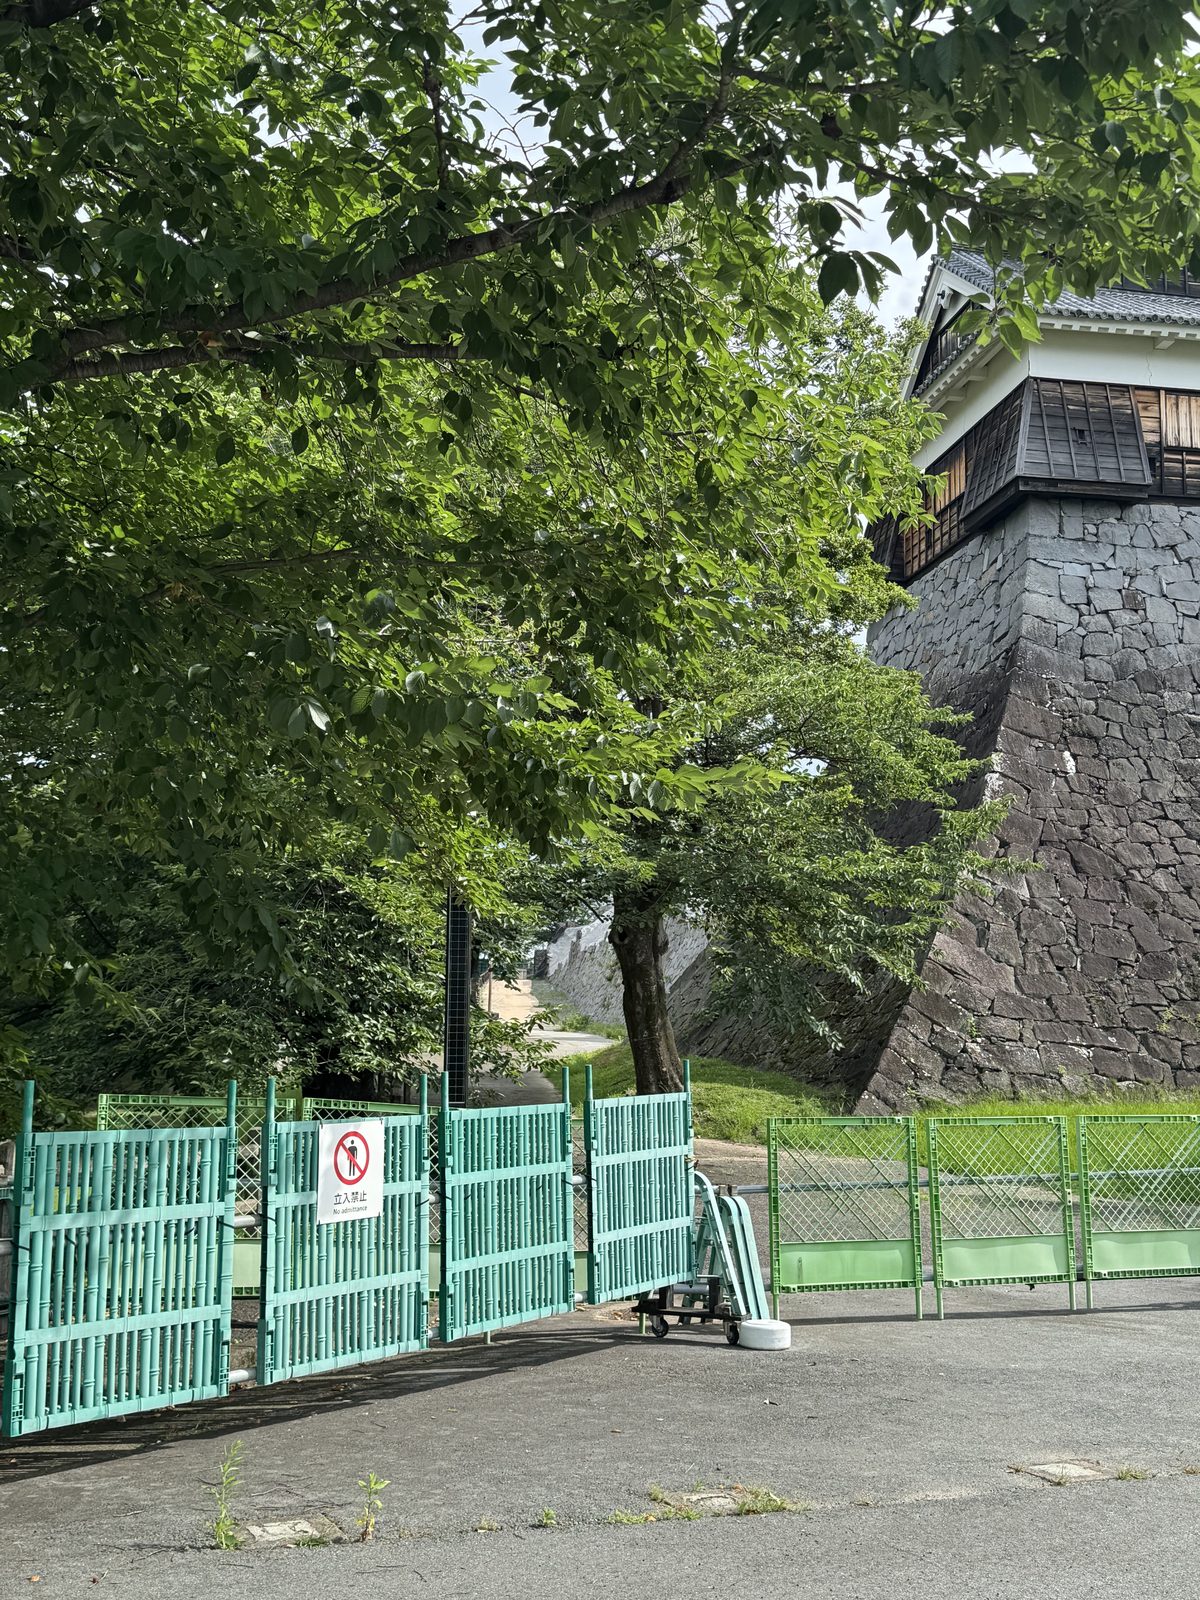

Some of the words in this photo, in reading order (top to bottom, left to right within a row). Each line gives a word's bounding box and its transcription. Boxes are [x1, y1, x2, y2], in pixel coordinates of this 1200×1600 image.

[334, 1190, 367, 1205] 立入禁止
[341, 1205, 367, 1214] admittance
